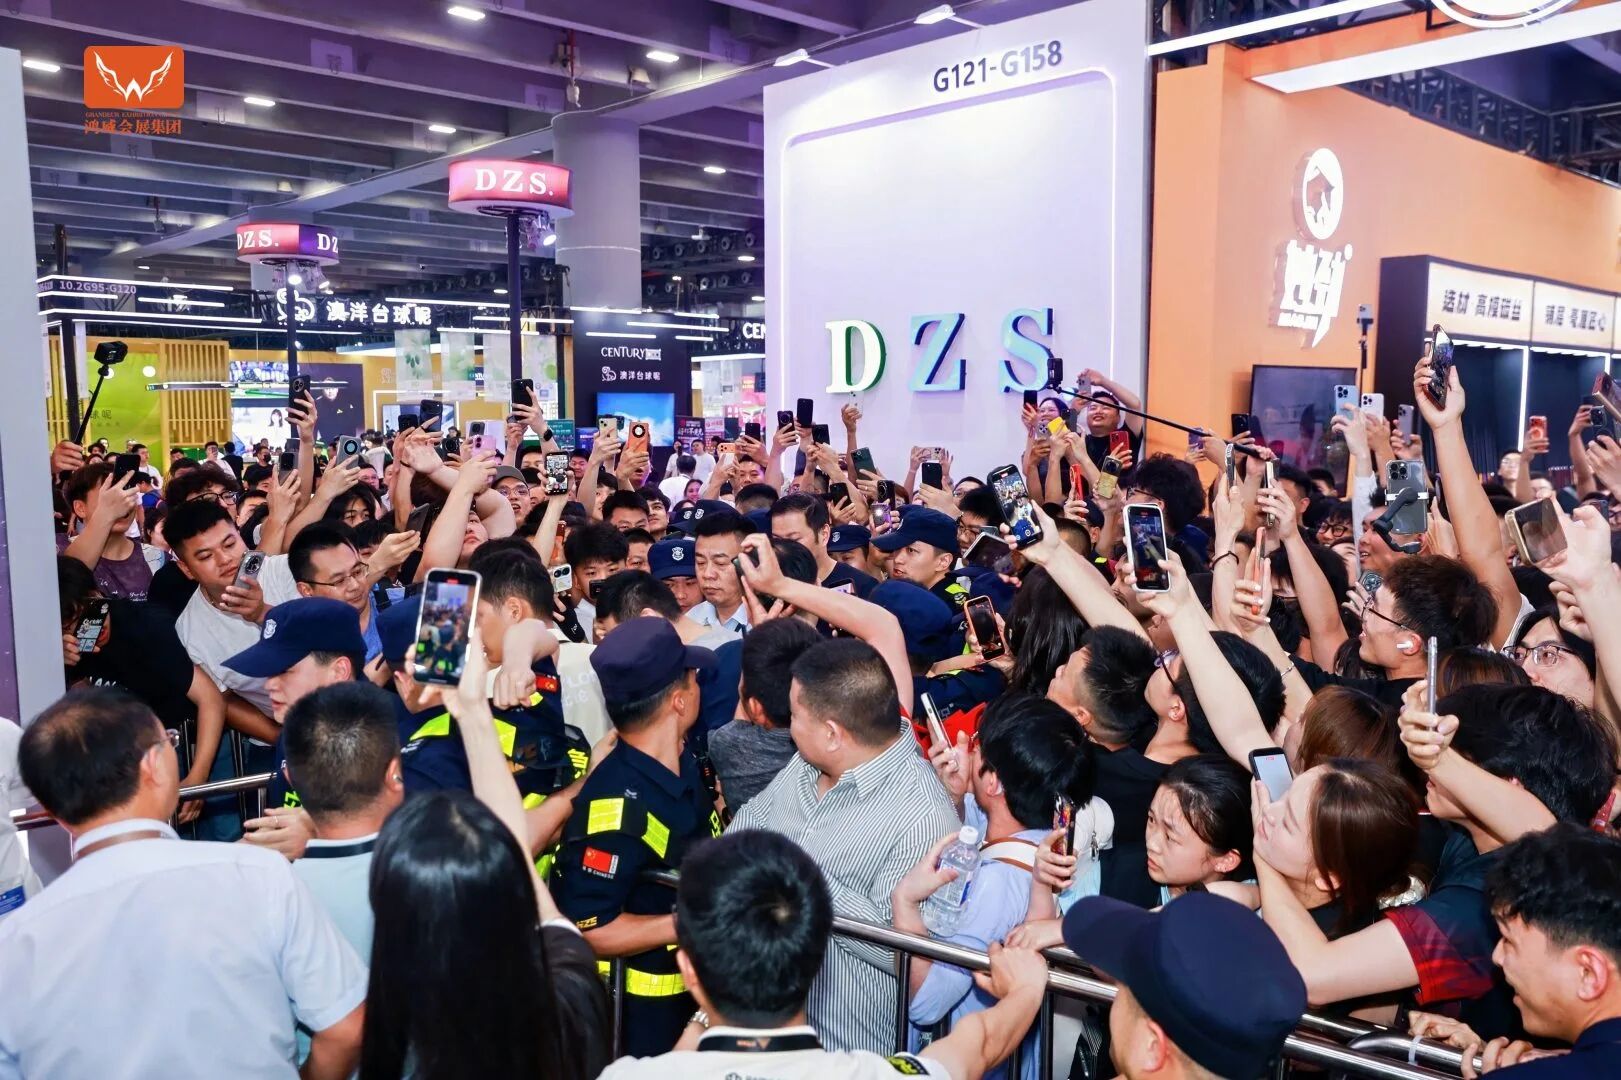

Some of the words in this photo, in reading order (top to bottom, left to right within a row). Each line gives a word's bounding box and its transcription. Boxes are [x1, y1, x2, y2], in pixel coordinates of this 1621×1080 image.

[933, 40, 1062, 93] G121-G158
[59, 280, 137, 294] 10.2G95-G120
[326, 300, 432, 326] 澳洋台球呢
[600, 346, 646, 360] CENTURY
[619, 370, 661, 381] 澳洋台球呢
